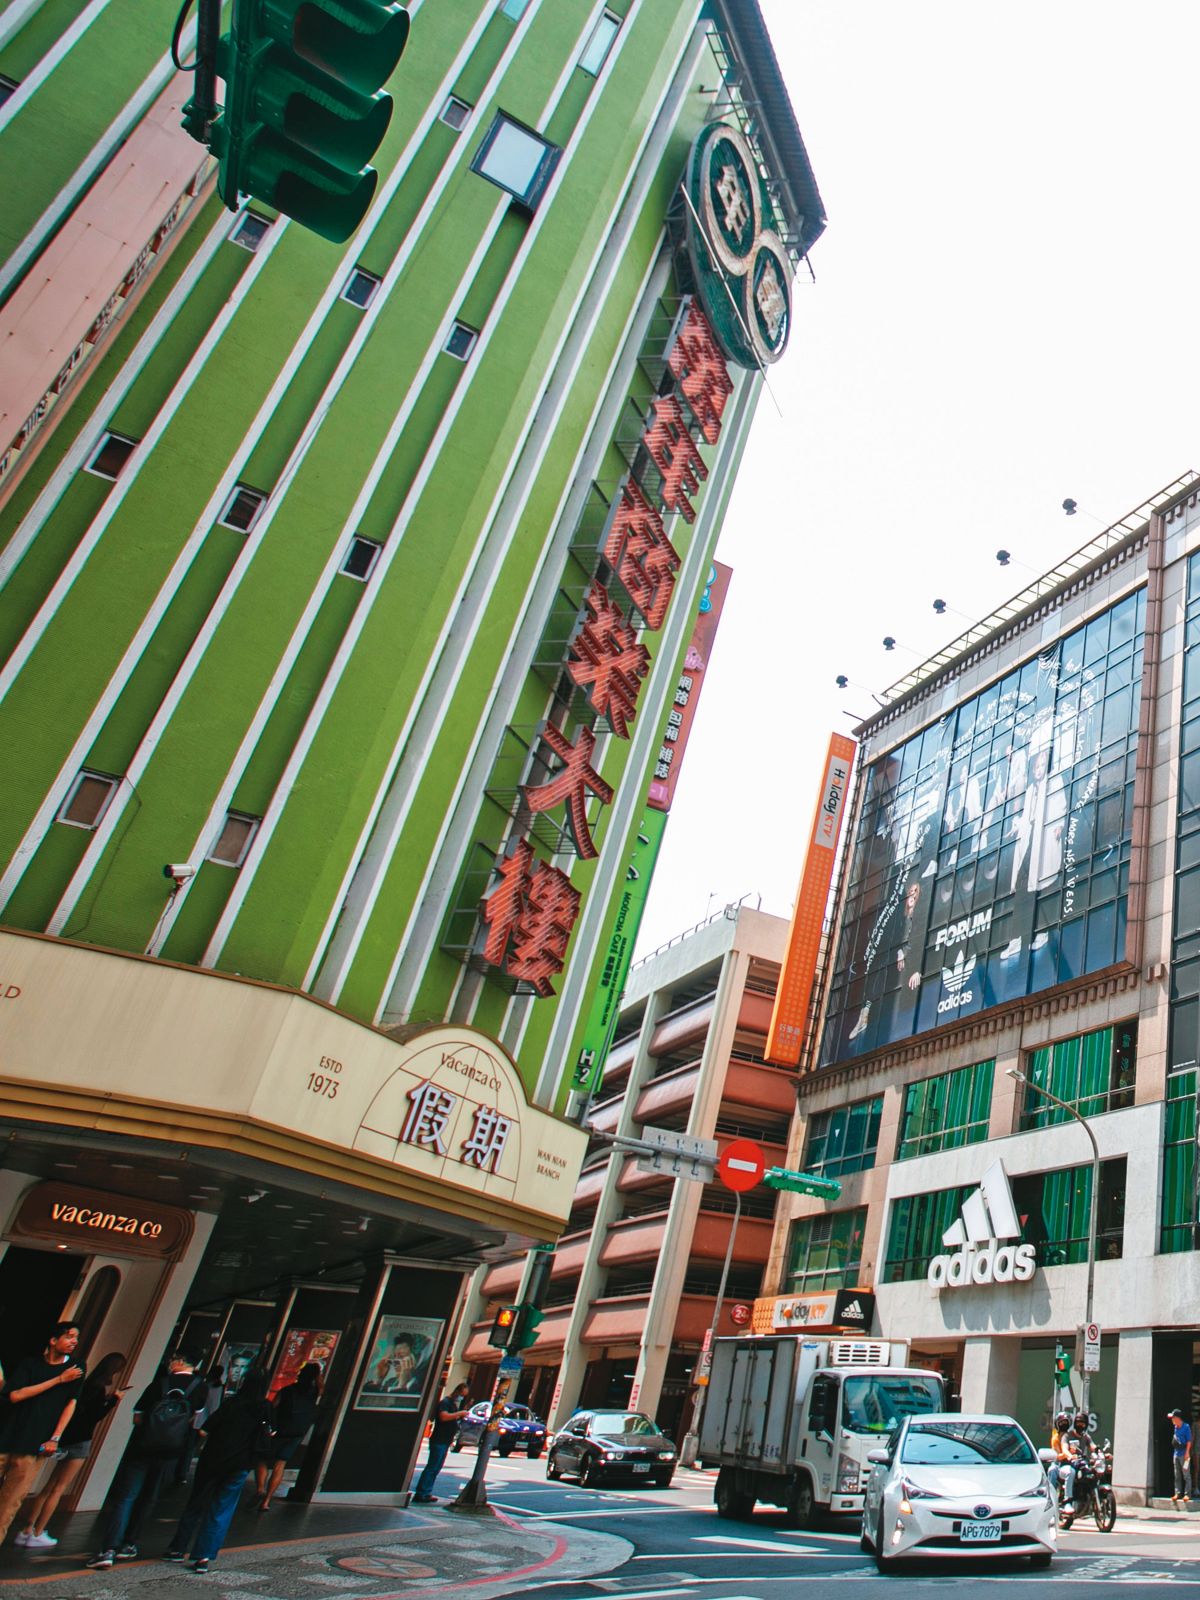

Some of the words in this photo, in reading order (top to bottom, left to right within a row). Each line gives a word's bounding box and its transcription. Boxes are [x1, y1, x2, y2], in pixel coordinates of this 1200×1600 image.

[823, 767, 846, 815] Holiday
[823, 814, 835, 838] KTV
[935, 908, 993, 951] FORUM
[937, 989, 973, 1013] adidas
[319, 1056, 343, 1074] ESTD
[307, 1072, 340, 1099] 1973
[401, 1079, 512, 1175] 假期
[536, 1164, 561, 1180] BRANCH
[928, 1240, 1037, 1290] adidas
[780, 1302, 810, 1324] Holiday
[841, 1311, 865, 1320] adidas
